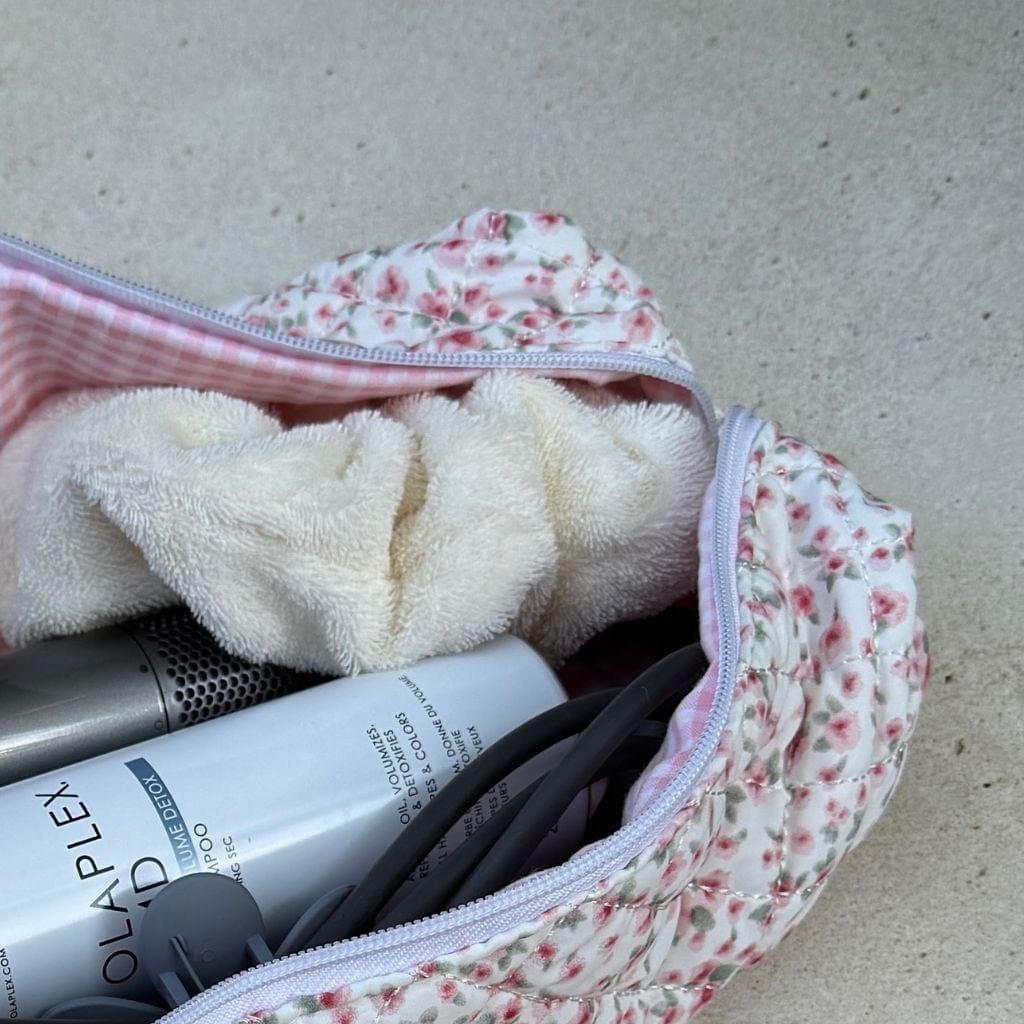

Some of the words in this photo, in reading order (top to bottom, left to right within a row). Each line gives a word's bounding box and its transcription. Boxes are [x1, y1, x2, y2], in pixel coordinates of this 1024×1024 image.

[398, 673, 427, 704] VOLUME
[423, 704, 438, 718] DU
[394, 711, 426, 761] COLORS
[432, 719, 456, 758] DONNE
[466, 725, 483, 754] VEUX
[383, 729, 419, 797] DETOXIFIES
[421, 764, 432, 774] &
[142, 774, 177, 821] DETOX
[412, 800, 422, 810] &
[169, 823, 196, 872] LUME
[222, 836, 237, 859] SEC
